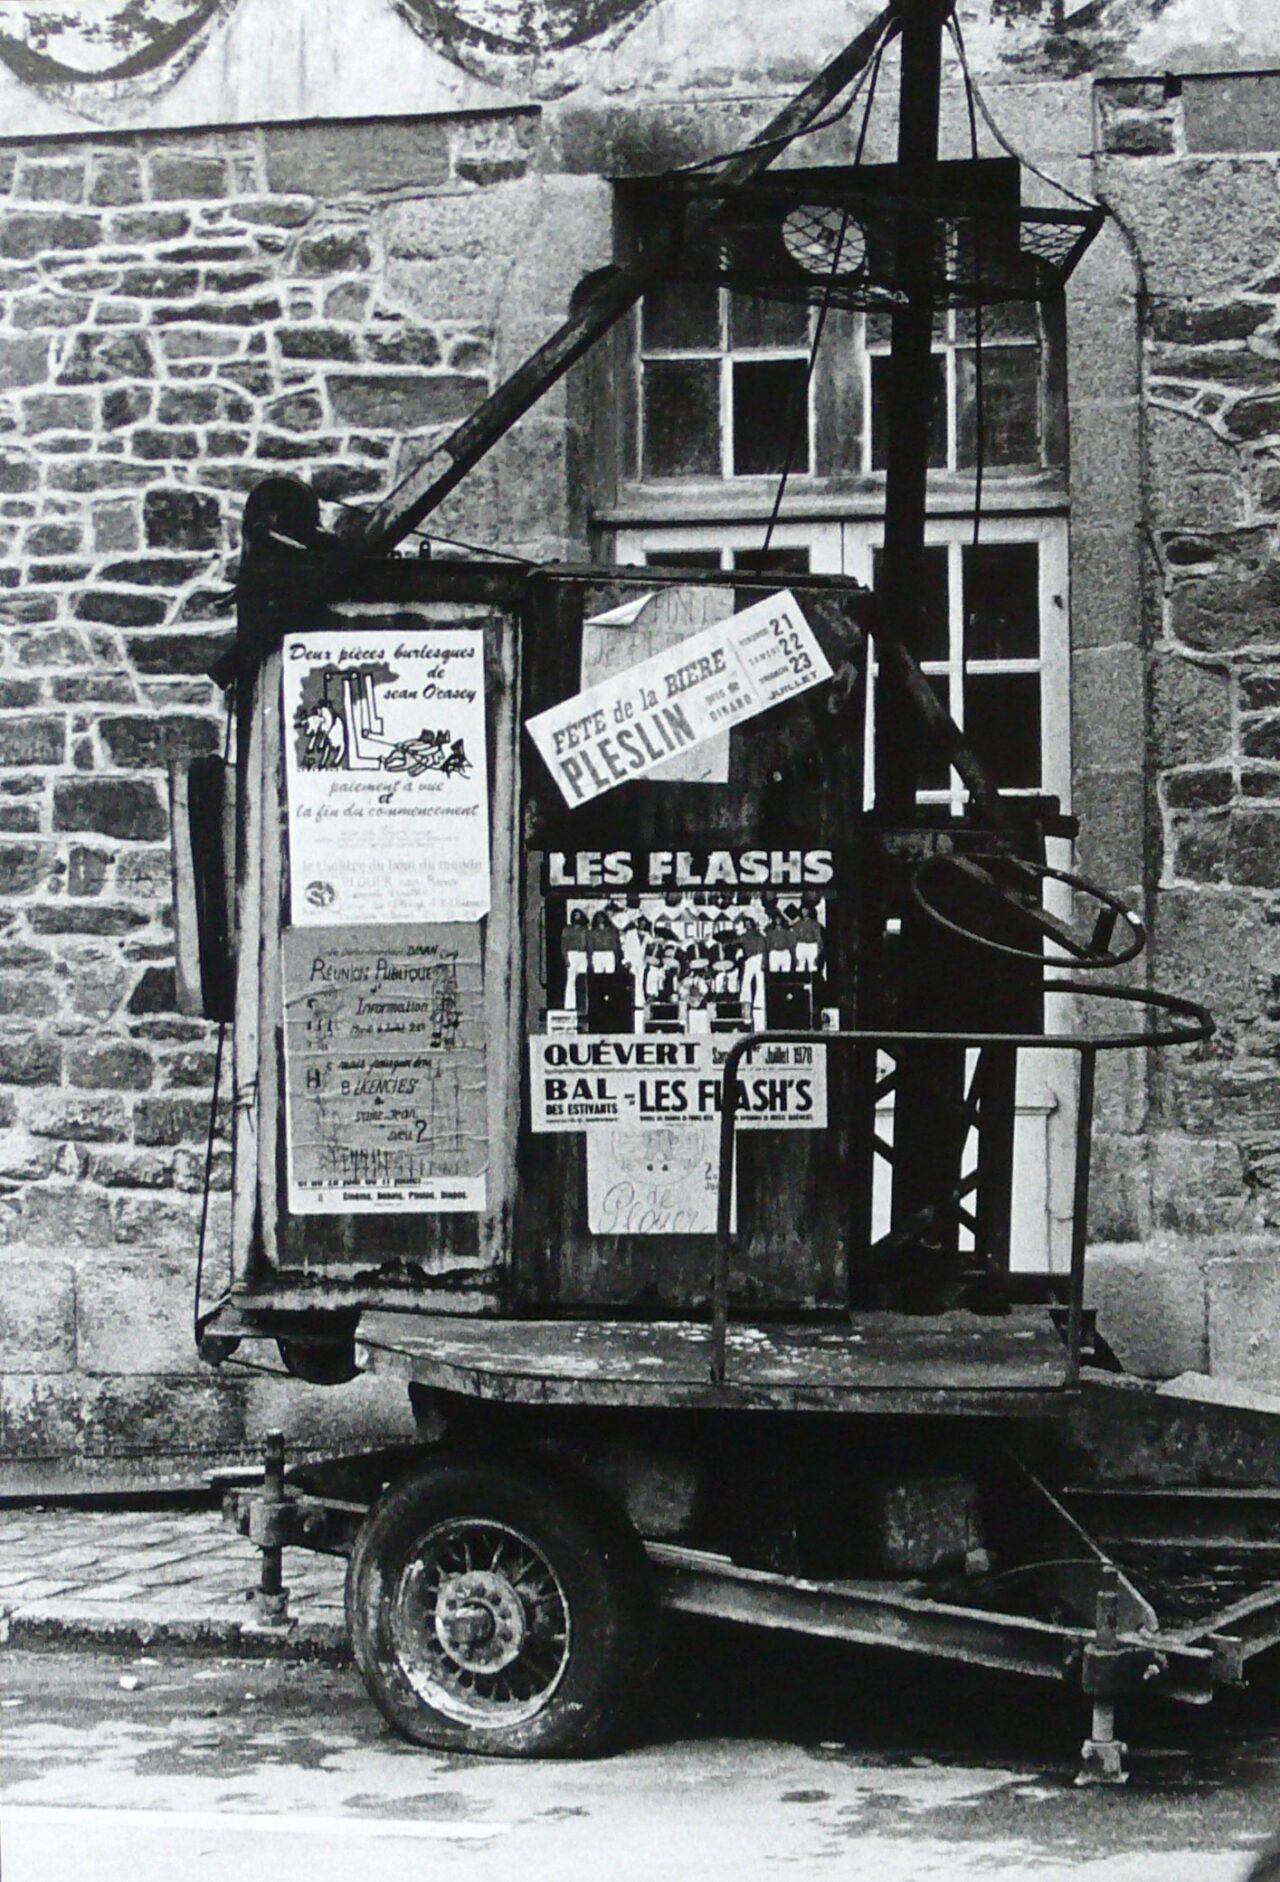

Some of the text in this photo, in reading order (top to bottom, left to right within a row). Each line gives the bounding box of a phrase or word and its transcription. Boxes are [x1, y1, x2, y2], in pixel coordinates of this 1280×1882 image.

[769, 613, 794, 636] 21
[289, 642, 475, 664] Deux pièces burlesques
[778, 632, 803, 656] 22
[427, 664, 445, 680] de
[789, 652, 812, 674] 23
[768, 671, 817, 700] JUILLET
[613, 700, 634, 724] de
[639, 688, 659, 711] la
[559, 703, 696, 798] PLESLIN
[329, 780, 401, 797] paiement
[418, 781, 444, 792] vue
[296, 803, 480, 822] la fin du commencement
[549, 850, 834, 886] LES FLASHS
[356, 997, 429, 1016] Information
[544, 1039, 700, 1066] QUÉVERT
[544, 1078, 617, 1100] BAL
[639, 1080, 687, 1112] LES
[546, 1103, 618, 1116] DES ESTIVANTS
